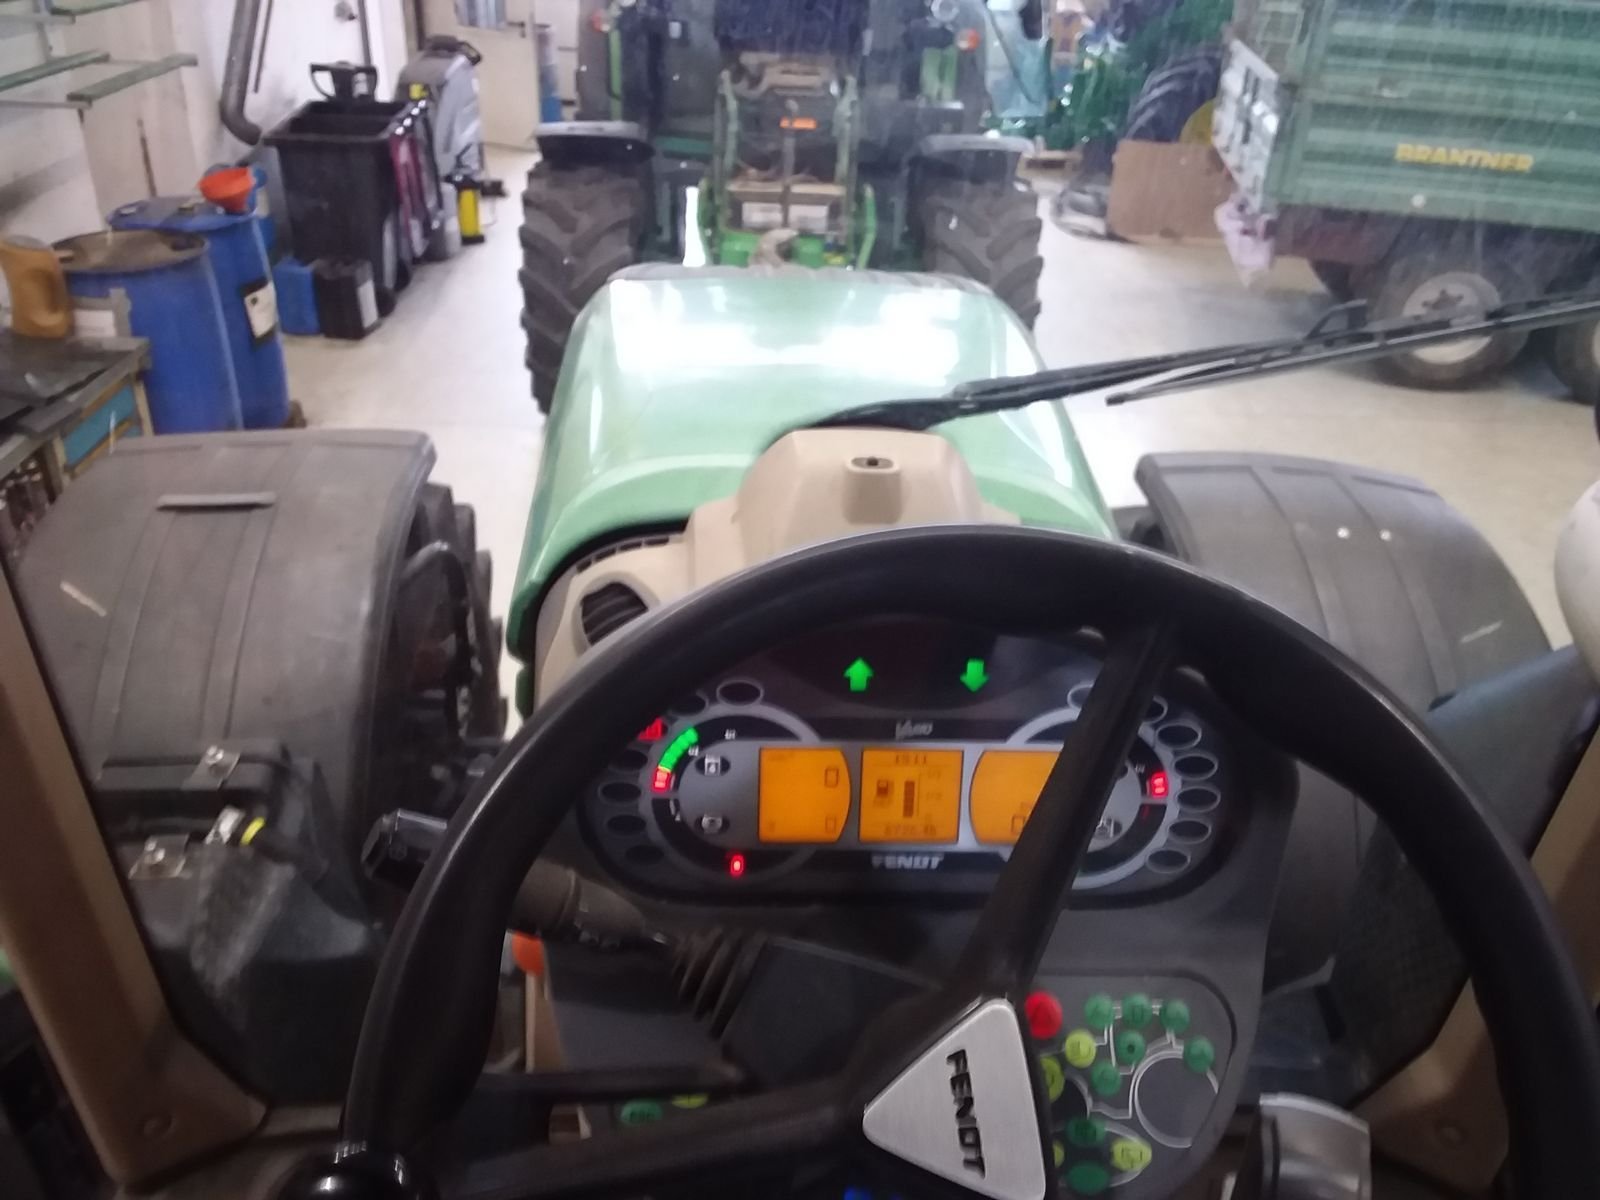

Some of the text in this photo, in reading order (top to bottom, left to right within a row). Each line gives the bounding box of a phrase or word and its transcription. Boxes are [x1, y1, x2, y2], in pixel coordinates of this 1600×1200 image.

[1396, 143, 1534, 172] BRANTNER
[871, 853, 944, 869] FENDT
[946, 1049, 986, 1179] FENDT
